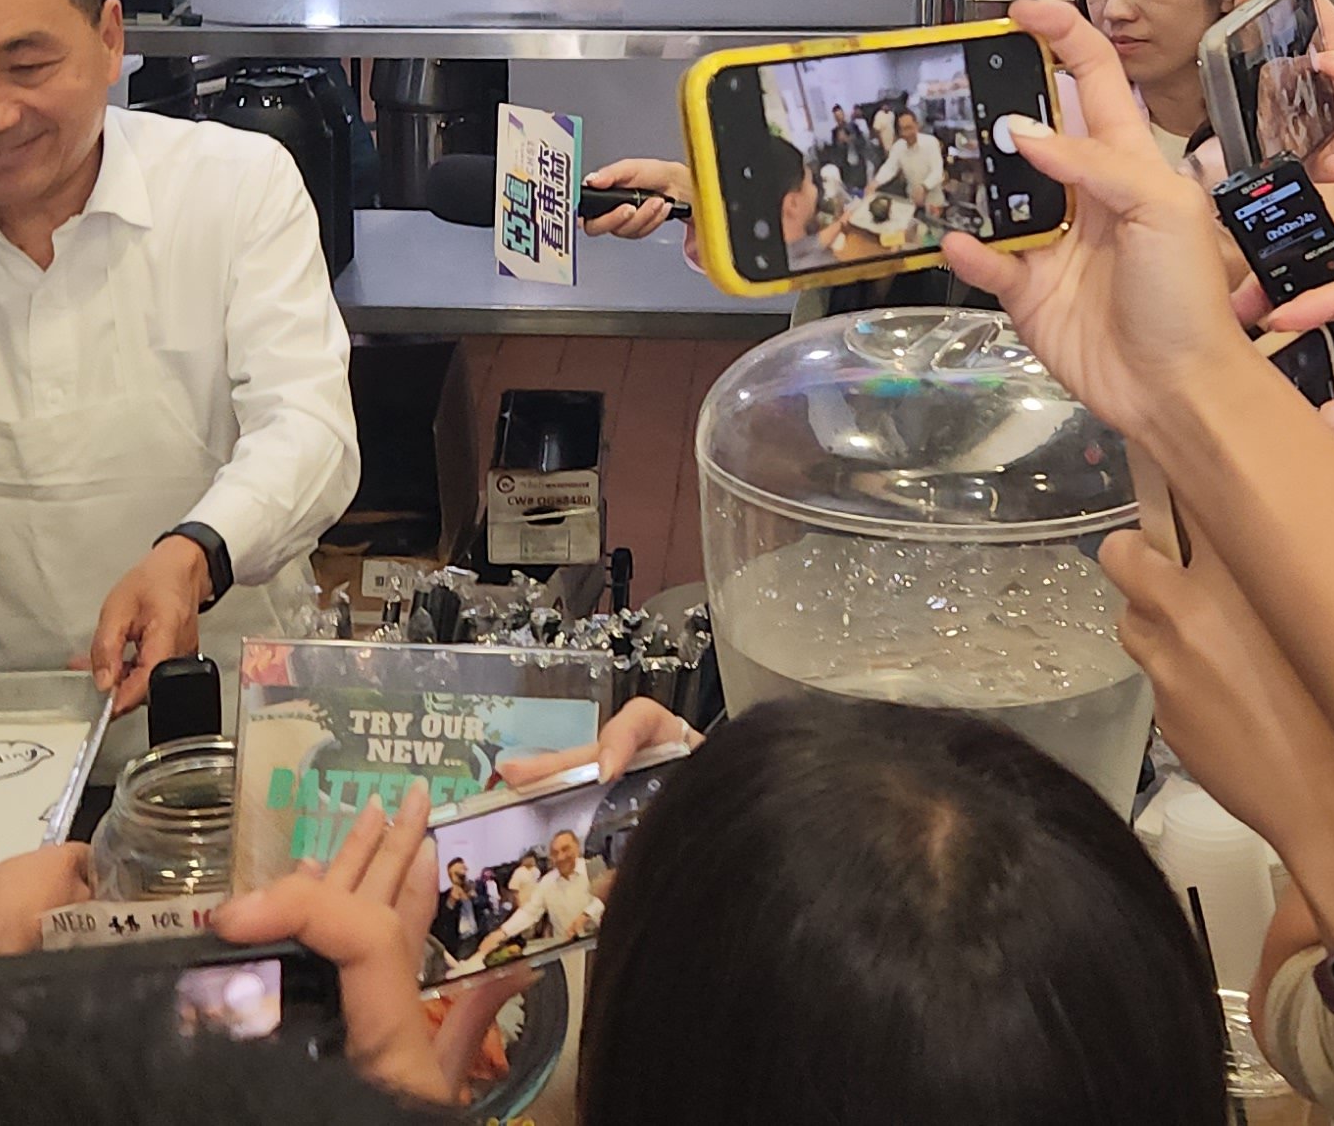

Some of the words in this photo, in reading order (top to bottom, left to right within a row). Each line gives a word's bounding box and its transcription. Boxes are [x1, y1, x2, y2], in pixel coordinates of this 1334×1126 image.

[537, 138, 566, 258] 看東森
[1240, 173, 1275, 194] SONY
[502, 172, 540, 264] 亞運
[348, 710, 414, 737] TRY
[420, 712, 485, 742] OUR
[366, 737, 462, 767] NEW...
